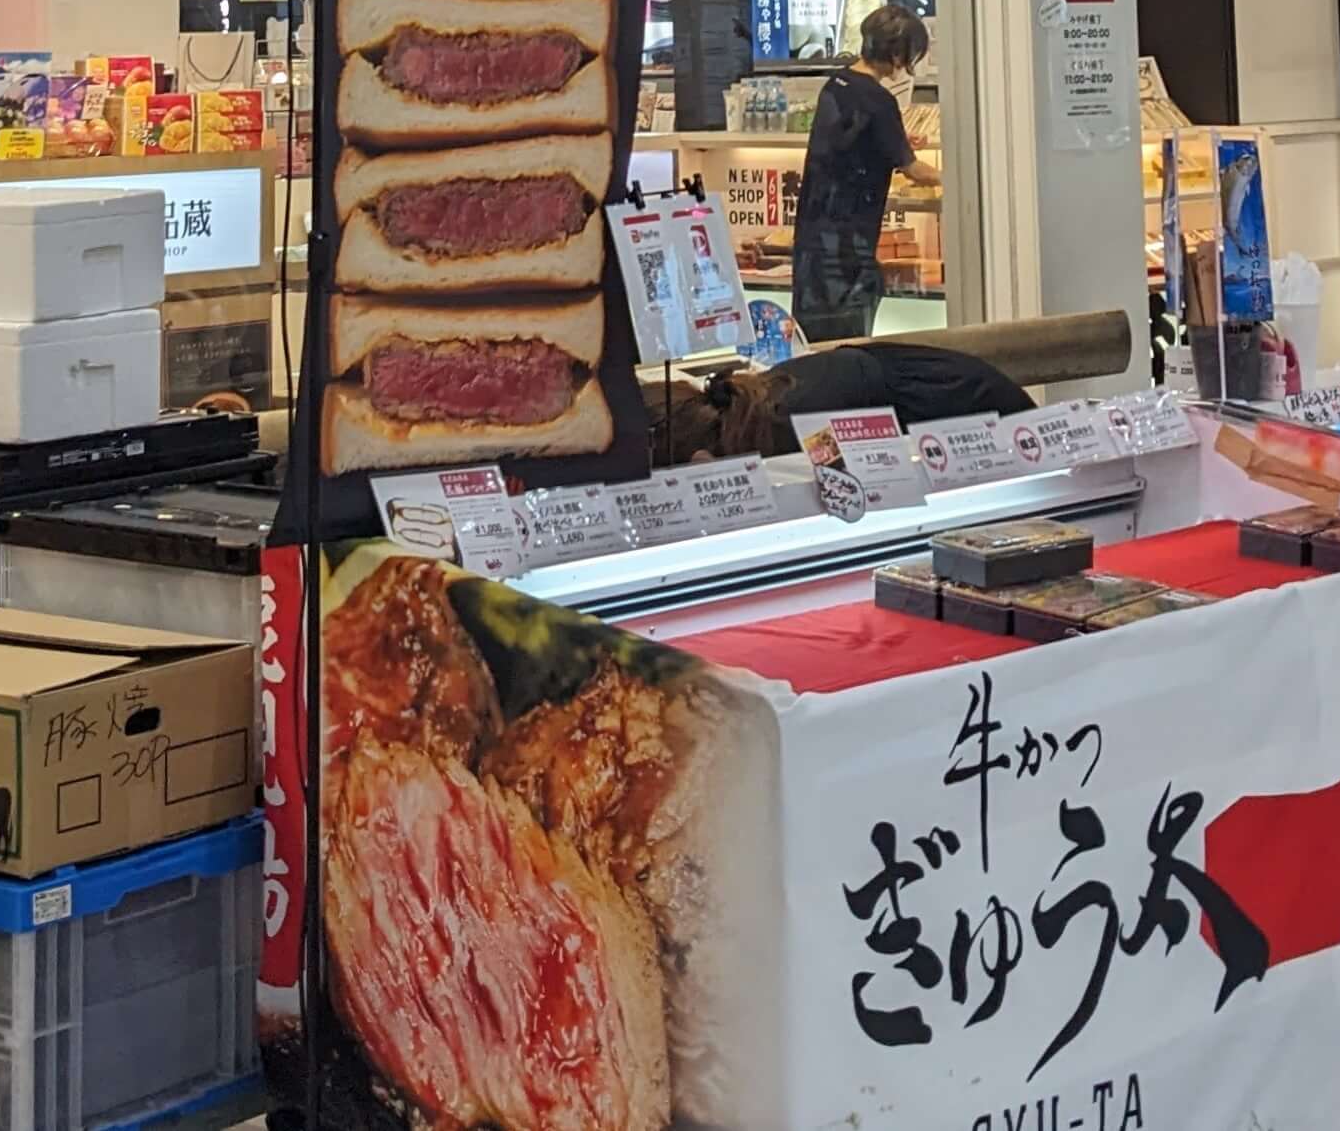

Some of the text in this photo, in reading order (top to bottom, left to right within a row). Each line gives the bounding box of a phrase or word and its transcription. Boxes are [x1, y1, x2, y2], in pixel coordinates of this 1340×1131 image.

[729, 169, 763, 183] NEW
[729, 189, 764, 203] SHOP
[729, 210, 764, 225] OPEN
[944, 671, 1102, 872] 牛かつ
[843, 782, 1270, 1082] ぎゅう太
